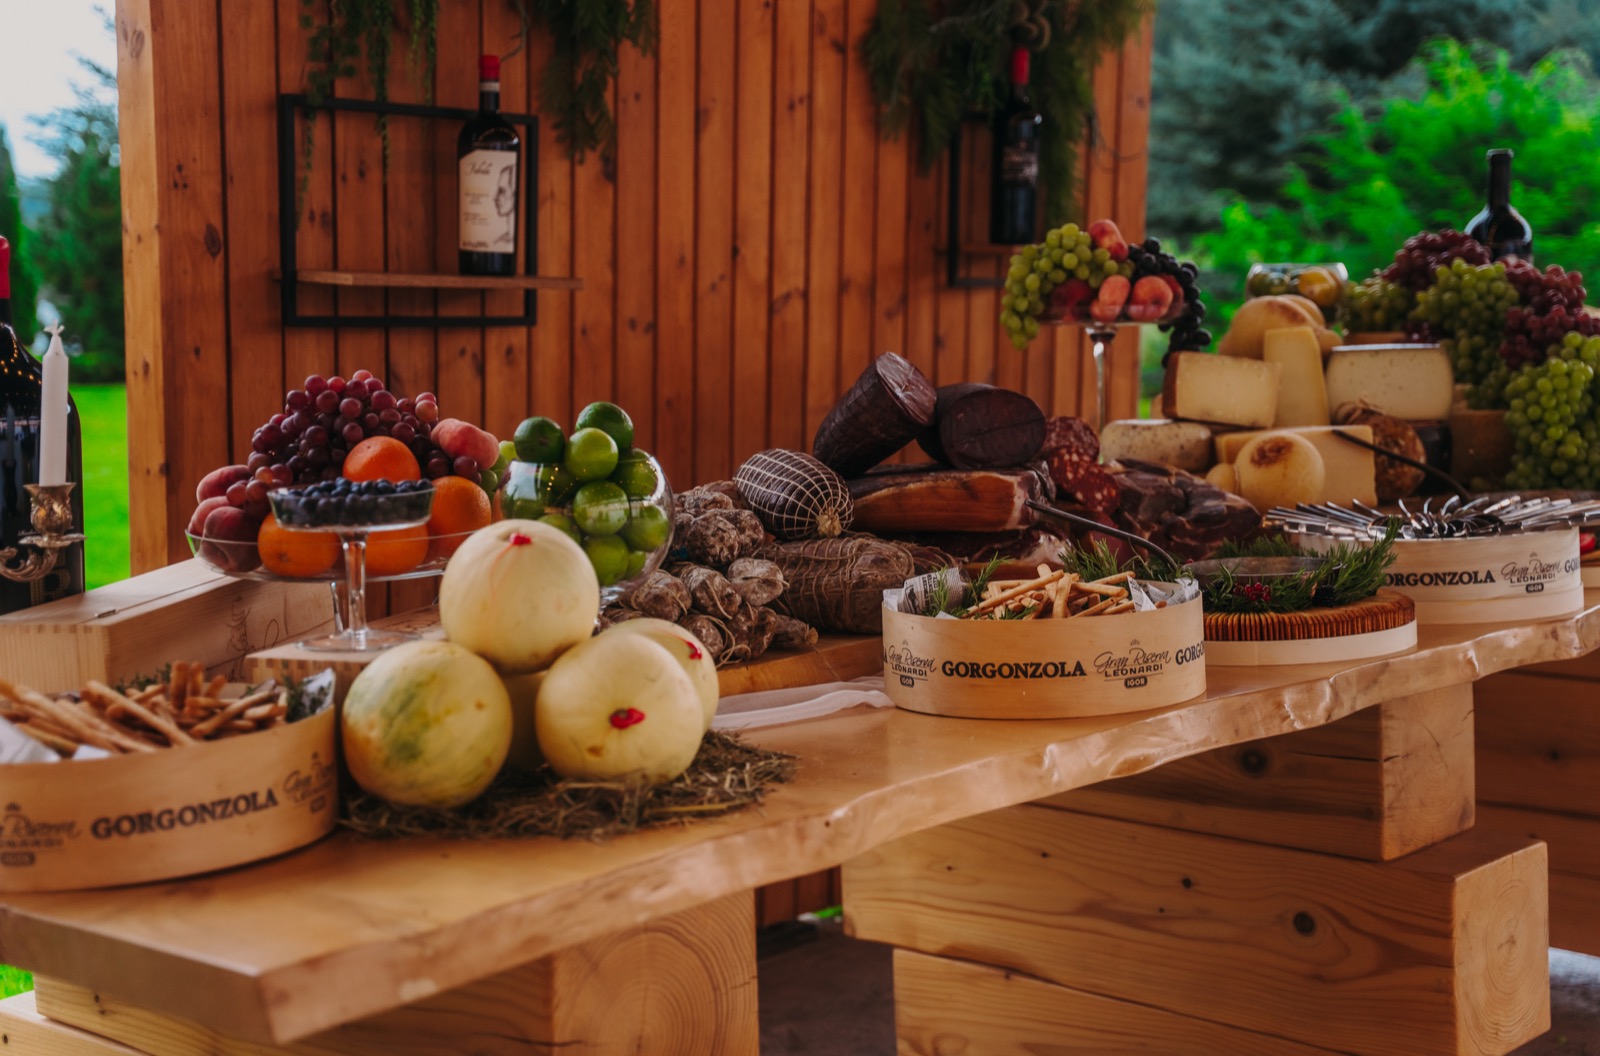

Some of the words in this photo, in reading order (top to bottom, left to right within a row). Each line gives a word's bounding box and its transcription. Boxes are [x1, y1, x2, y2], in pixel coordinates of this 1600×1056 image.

[1385, 570, 1496, 586] ORGONZOLA
[1510, 573, 1556, 584] LEONARDI
[891, 658, 927, 676] LEONARDI
[1094, 651, 1129, 674] Gran
[1129, 647, 1171, 666] Riserva
[942, 660, 1087, 679] GORGONZOLA
[1104, 664, 1163, 677] LEONARDI
[1126, 678, 1146, 687] IGOR
[90, 788, 279, 840] GORGONZOLA
